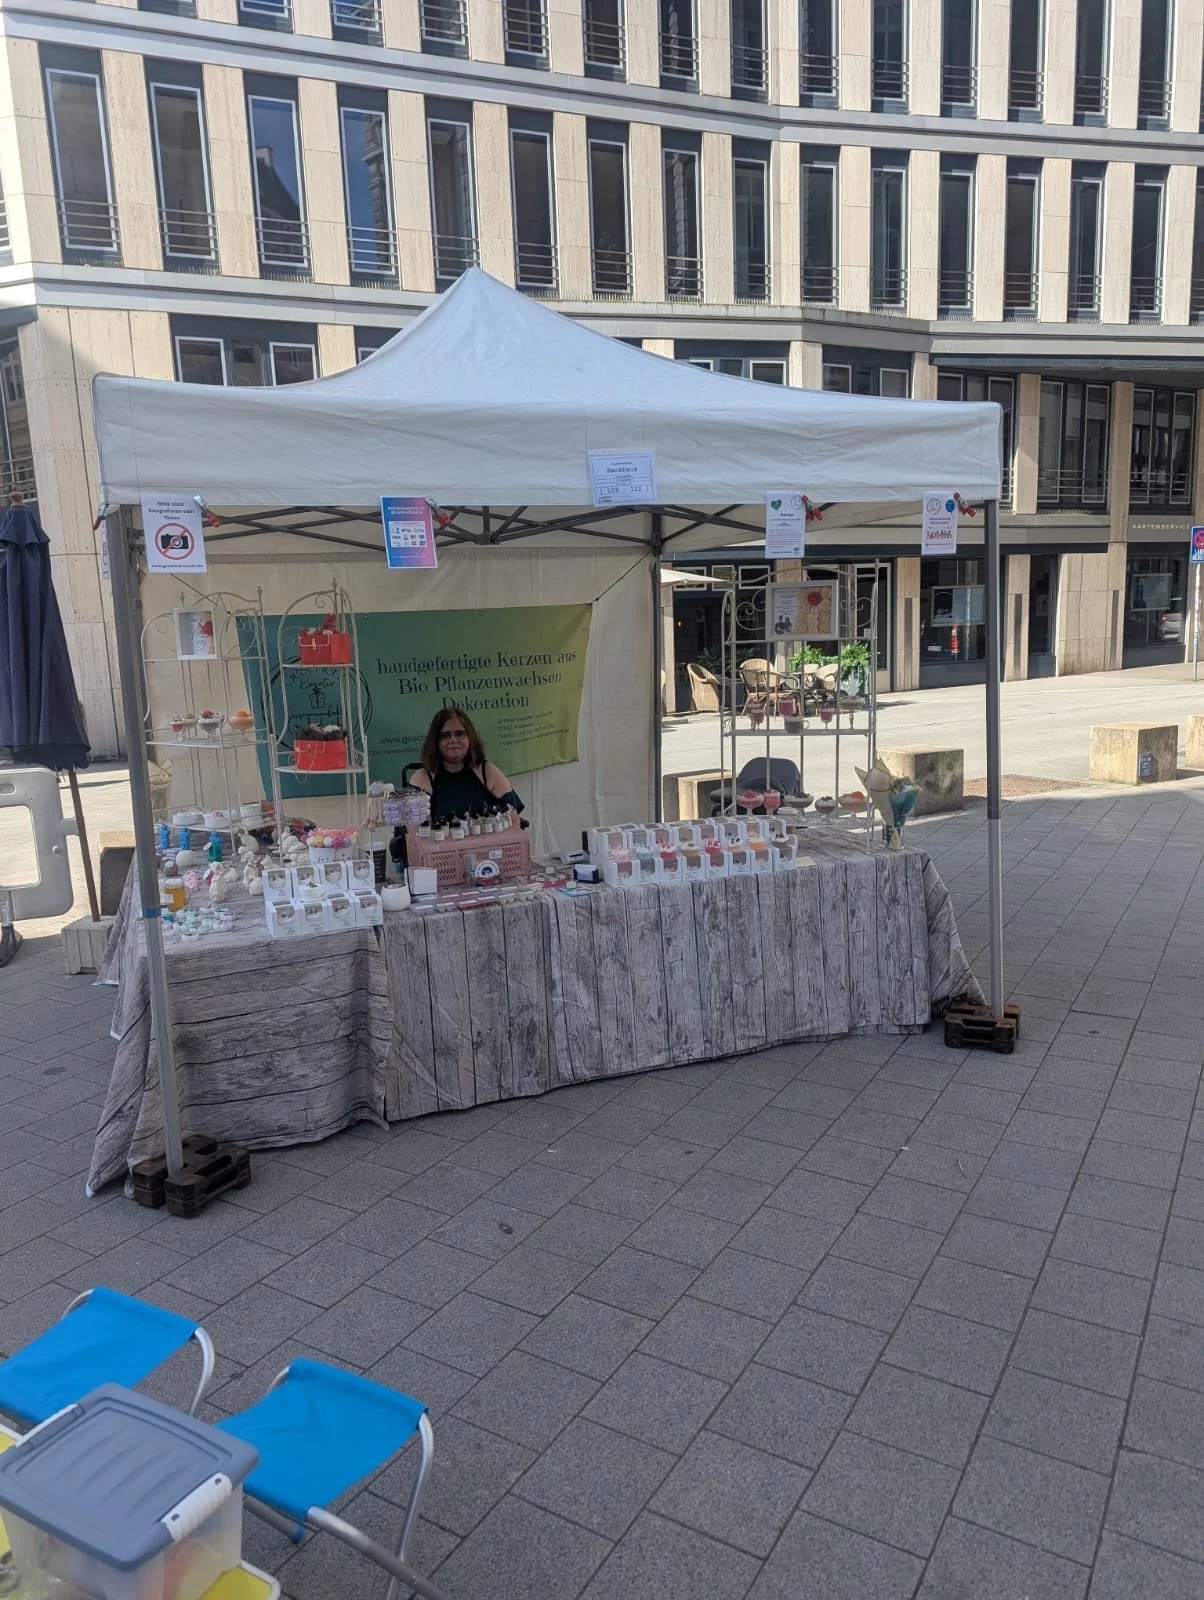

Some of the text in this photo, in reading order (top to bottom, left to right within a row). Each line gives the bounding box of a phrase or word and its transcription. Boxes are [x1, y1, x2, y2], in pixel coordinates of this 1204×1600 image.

[376, 651, 577, 676] handgefertigte Kerzen aus
[399, 670, 562, 695] Bio Pflanzenwachsen
[442, 693, 529, 712] Dekoration
